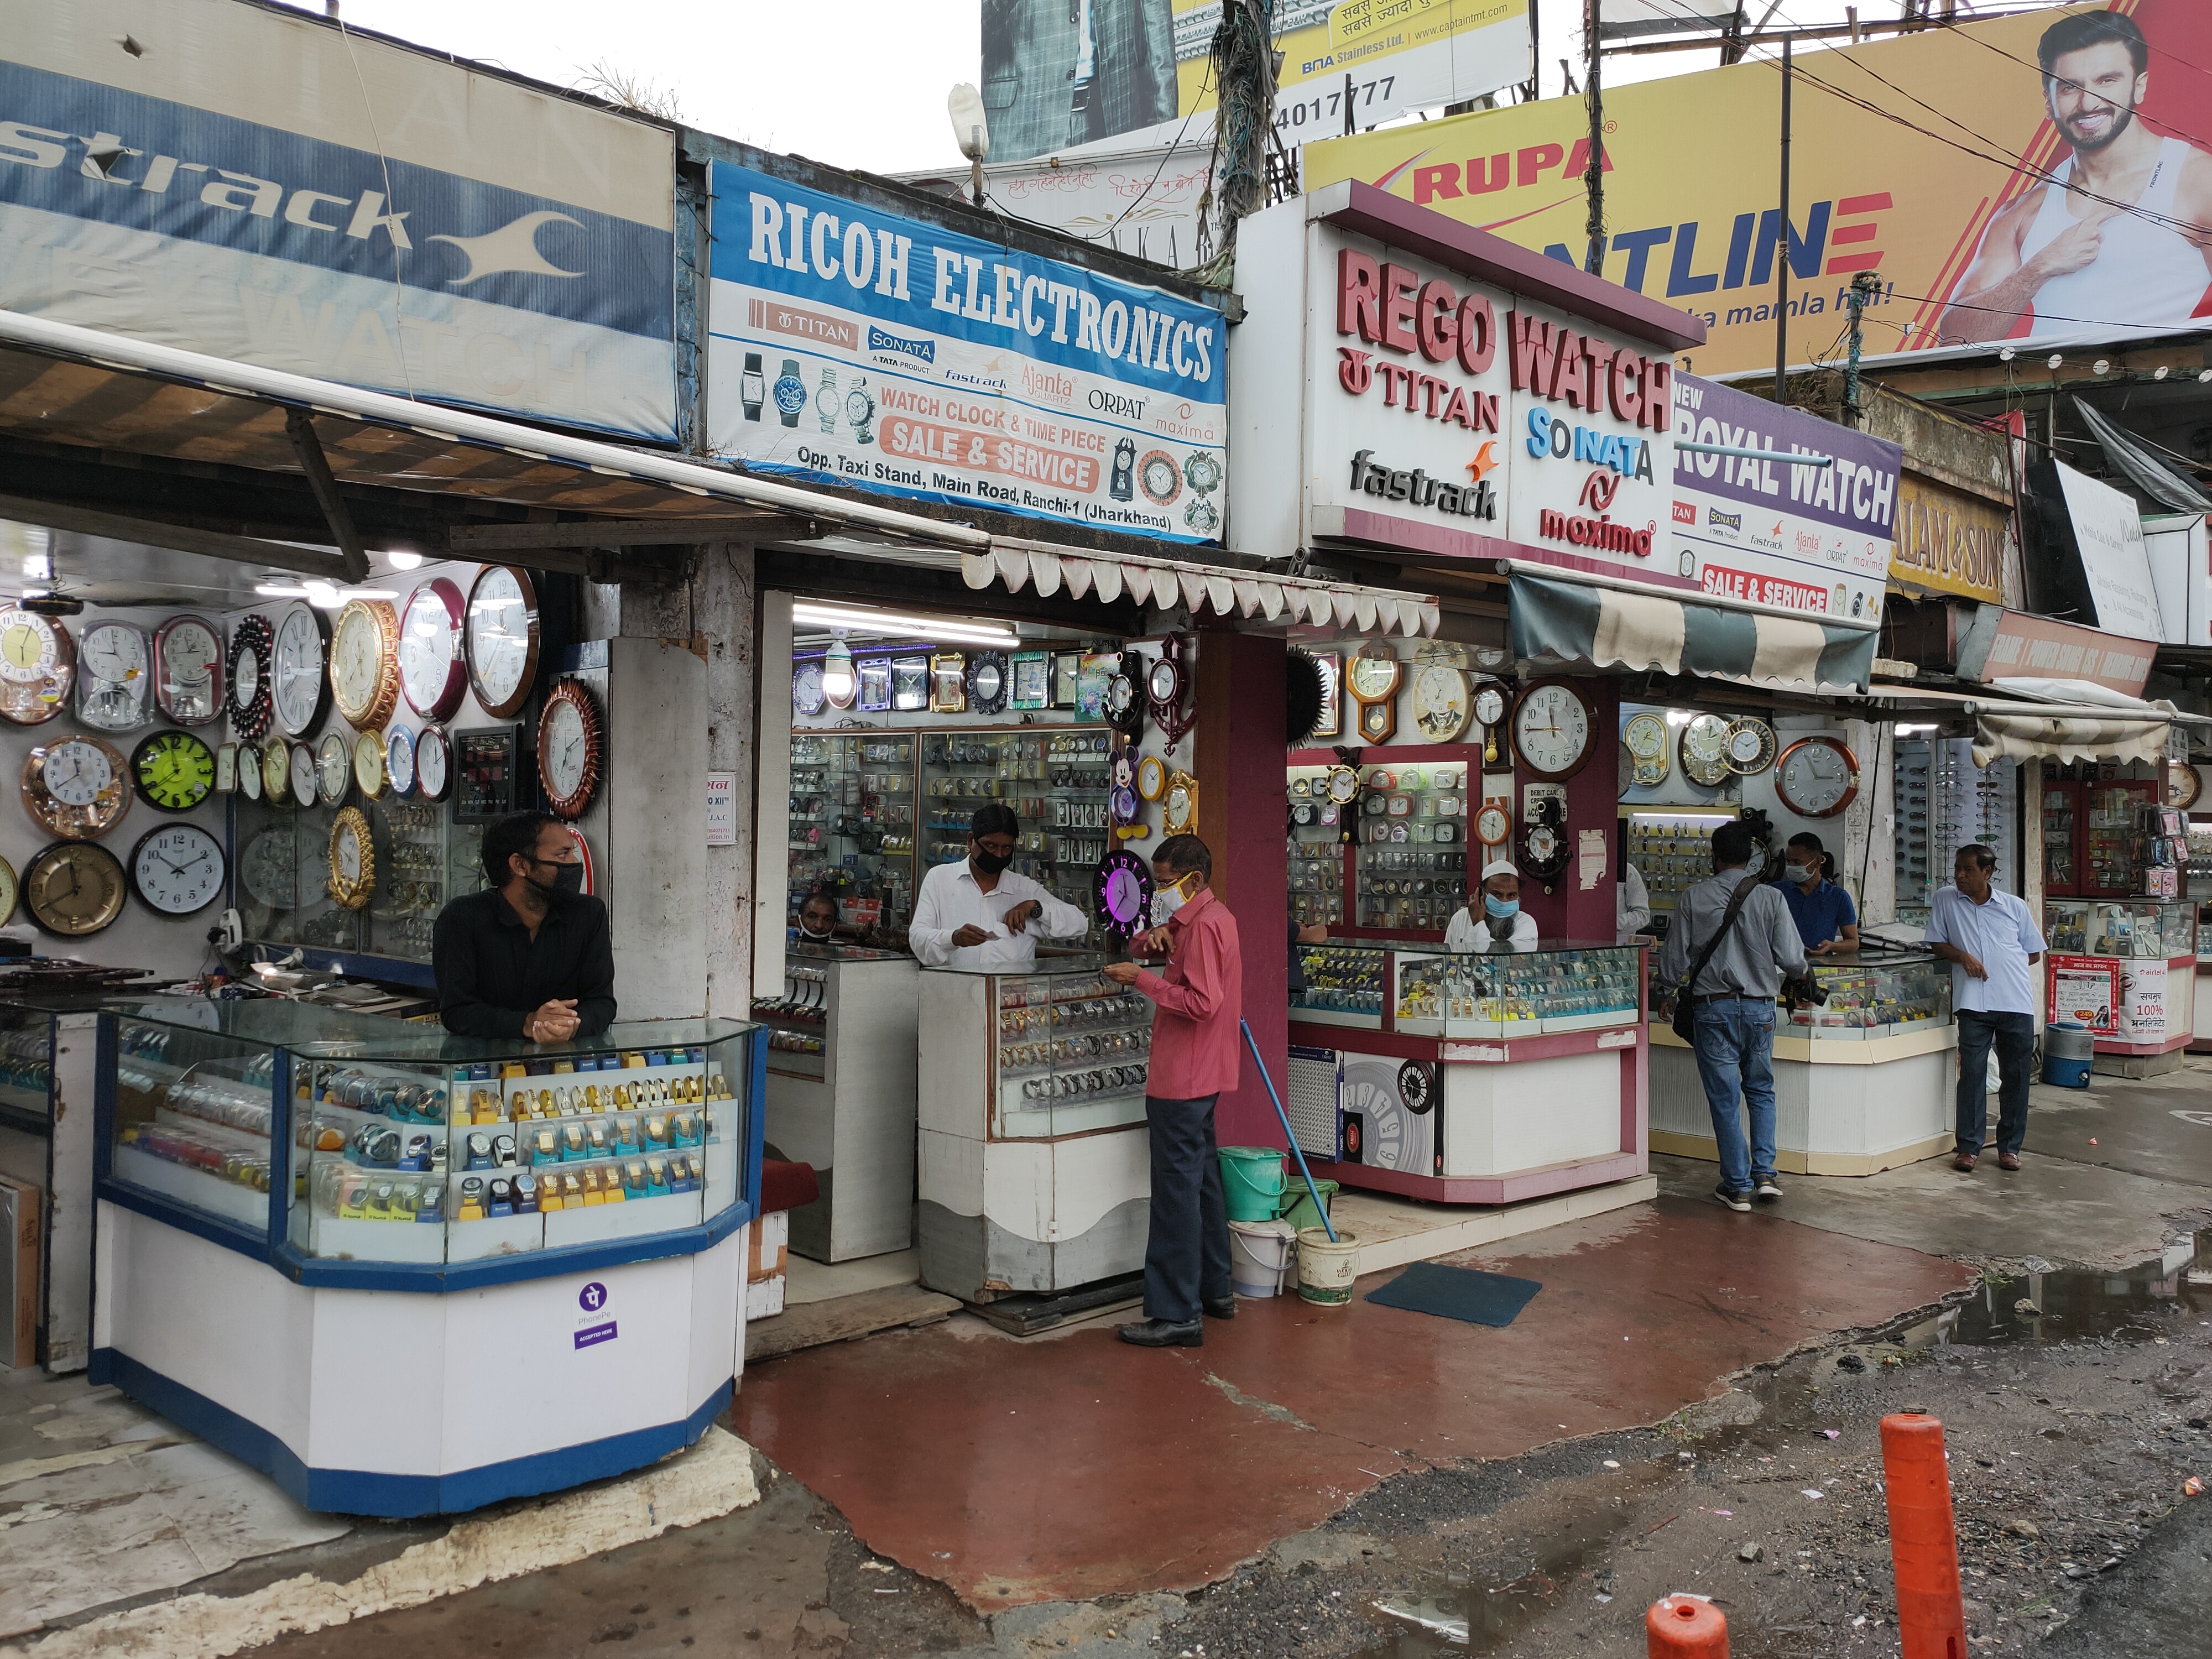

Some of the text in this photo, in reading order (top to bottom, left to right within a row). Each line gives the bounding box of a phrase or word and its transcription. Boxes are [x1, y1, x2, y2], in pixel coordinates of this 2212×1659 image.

[1337, 40, 1385, 64] Stainless
[1387, 33, 1405, 49] Ltd.
[1415, 3, 1508, 40] www.captaintmt.com
[1342, 12, 1372, 36] सबसे
[1413, 138, 1614, 205] RUPA
[2150, 160, 2164, 188] FRONTLINE
[748, 190, 1213, 384] RICOH ELECTRONICS
[1835, 282, 1893, 311] hi!
[795, 316, 849, 342] TITAN
[1337, 247, 1671, 432] REGO WATCH
[872, 332, 932, 359] SONATA
[879, 356, 899, 366] TATA
[900, 361, 930, 374] PRODUCT
[945, 369, 1007, 389] fastrack
[1022, 362, 1073, 397] Ajanta
[1034, 390, 1071, 406] QUARTZ
[1088, 389, 1146, 420] ORPAT
[1375, 361, 1501, 434] TITAN
[1674, 381, 1703, 410] NEW
[881, 387, 1106, 453] WATCH CLOCK & TIME PIECE
[1156, 418, 1214, 441] maxima
[893, 421, 1091, 489] SALE & SERVICE
[1674, 406, 1895, 526] ROYAL WATCH
[798, 446, 1172, 531] Opp. Taxi Stand, Main Road, Ranchi-1 (Jharkhand)
[1350, 448, 1497, 521] fastrack
[1540, 508, 1652, 557] maxima
[1710, 510, 1740, 528] SONATA
[2120, 518, 2143, 543] Watch
[1712, 529, 1724, 538] TATA
[1724, 532, 1739, 540] Product
[1750, 535, 1783, 550] fastrack
[1794, 529, 1819, 552] Ajanta
[1826, 549, 1846, 564] ORPAT
[1853, 556, 1883, 571] maxima
[1950, 524, 1964, 581] &
[1703, 568, 1826, 613] SALE & SERVICE
[1988, 633, 2025, 665] FRAME
[2025, 639, 2060, 670] POWER
[2136, 1004, 2163, 1016] 100%
[2140, 993, 2162, 1003] सचमुच
[2131, 1017, 2166, 1028] अनलिमिटेड
[578, 1311, 611, 1326] PhonePe
[579, 1332, 601, 1342] ACCEPTED
